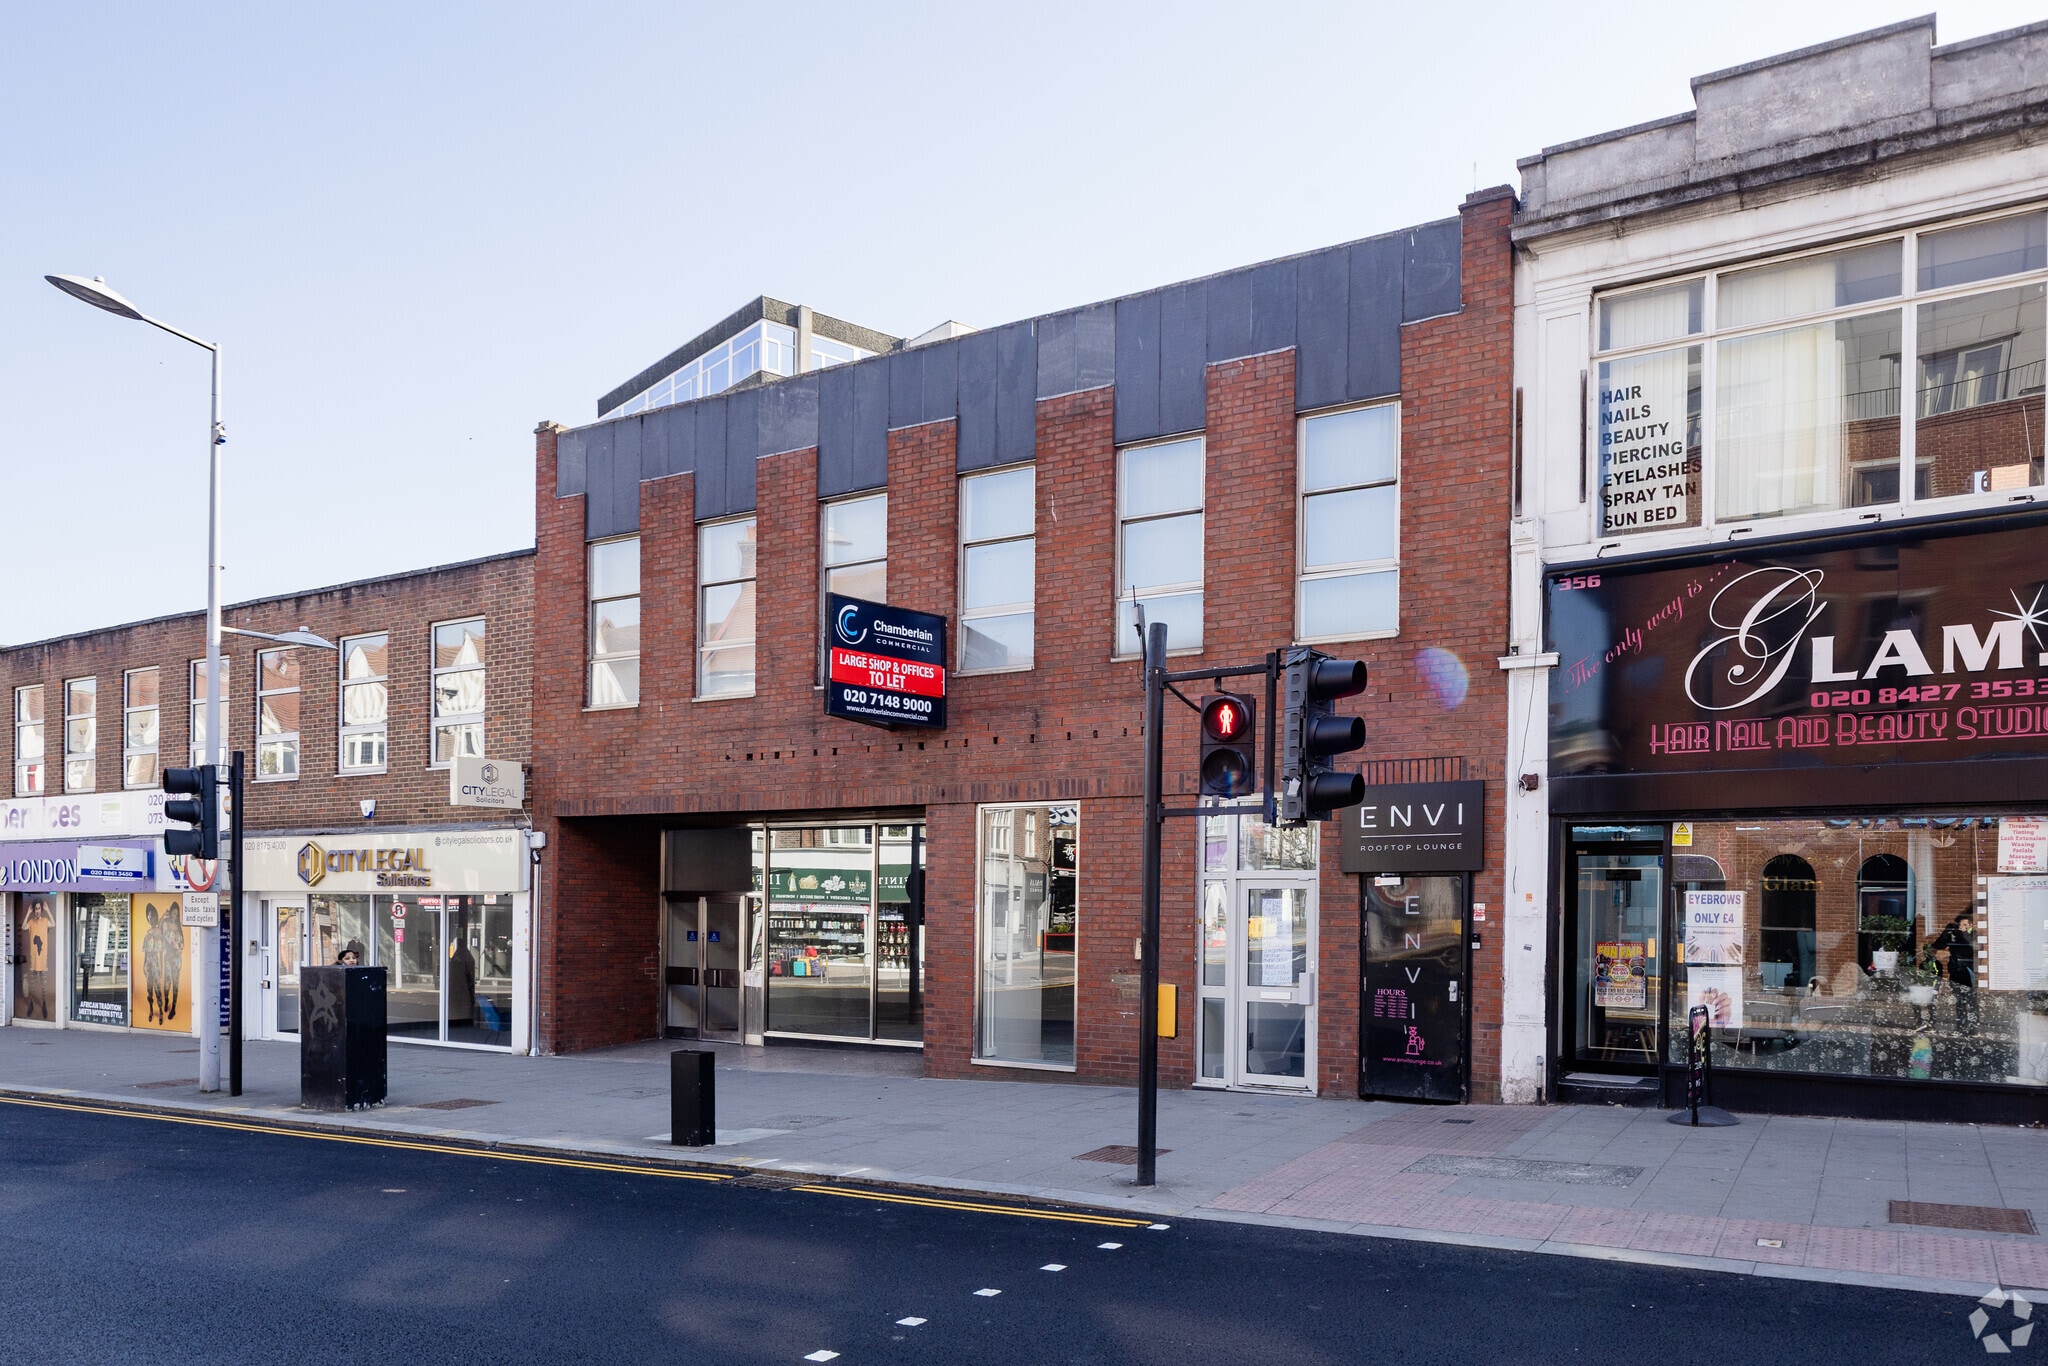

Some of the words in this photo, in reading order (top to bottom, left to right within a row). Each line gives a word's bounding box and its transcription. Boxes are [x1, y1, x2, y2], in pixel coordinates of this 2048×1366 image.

[1602, 385, 1641, 405] HAIR
[1602, 404, 1651, 426] NAILS
[1602, 422, 1669, 446] BEAUTY
[1602, 441, 1683, 467] PIERCING
[1603, 460, 1702, 488] EYELASHES
[1603, 487, 1657, 508] SPRAY
[1663, 481, 1697, 499] TAN
[1603, 511, 1638, 529] SUN
[1644, 506, 1677, 523] BED
[1559, 575, 1600, 591] 356
[873, 619, 933, 641] Chamberlain
[876, 638, 930, 653] COMMERCIAL
[1562, 654, 1600, 694] The
[1605, 626, 1645, 665] only
[1646, 594, 1687, 631] way
[839, 653, 867, 668] LARGE
[868, 657, 891, 671] SHOP
[893, 661, 900, 673] &
[901, 663, 934, 679] OFFICES
[869, 671, 884, 685] TO
[886, 673, 906, 689] LET
[843, 689, 867, 704] 020
[869, 692, 900, 709] 7148
[902, 697, 932, 713] 9000
[1811, 690, 1870, 708] 020
[1878, 684, 1961, 704] 8427
[845, 705, 928, 721] www.chamberlaincommercial.com
[461, 785, 518, 798] CITYLEGAL
[476, 796, 505, 804] Solicitors
[148, 795, 164, 806] 020
[0, 799, 81, 829] Serices
[148, 813, 163, 825] 073
[1361, 803, 1463, 828] ENVI
[1360, 844, 1412, 852] ROOFTOP
[1416, 843, 1463, 851] LOUNGE
[325, 848, 431, 872] CITYLEGAL
[11, 858, 78, 884] LONDON
[376, 872, 431, 887] Solicitors
[1762, 875, 1825, 892] Glam
[191, 895, 209, 904] Except
[1688, 894, 1741, 905] EYEBROWS
[197, 915, 214, 923] cycles
[1694, 912, 1720, 924] ONLY
[1723, 912, 1734, 924] £4
[1597, 945, 1618, 959] FUN
[1620, 945, 1643, 959] FAIR
[1377, 988, 1406, 996] HOURS
[1382, 1057, 1442, 1066] www.envilounge.co.uk
